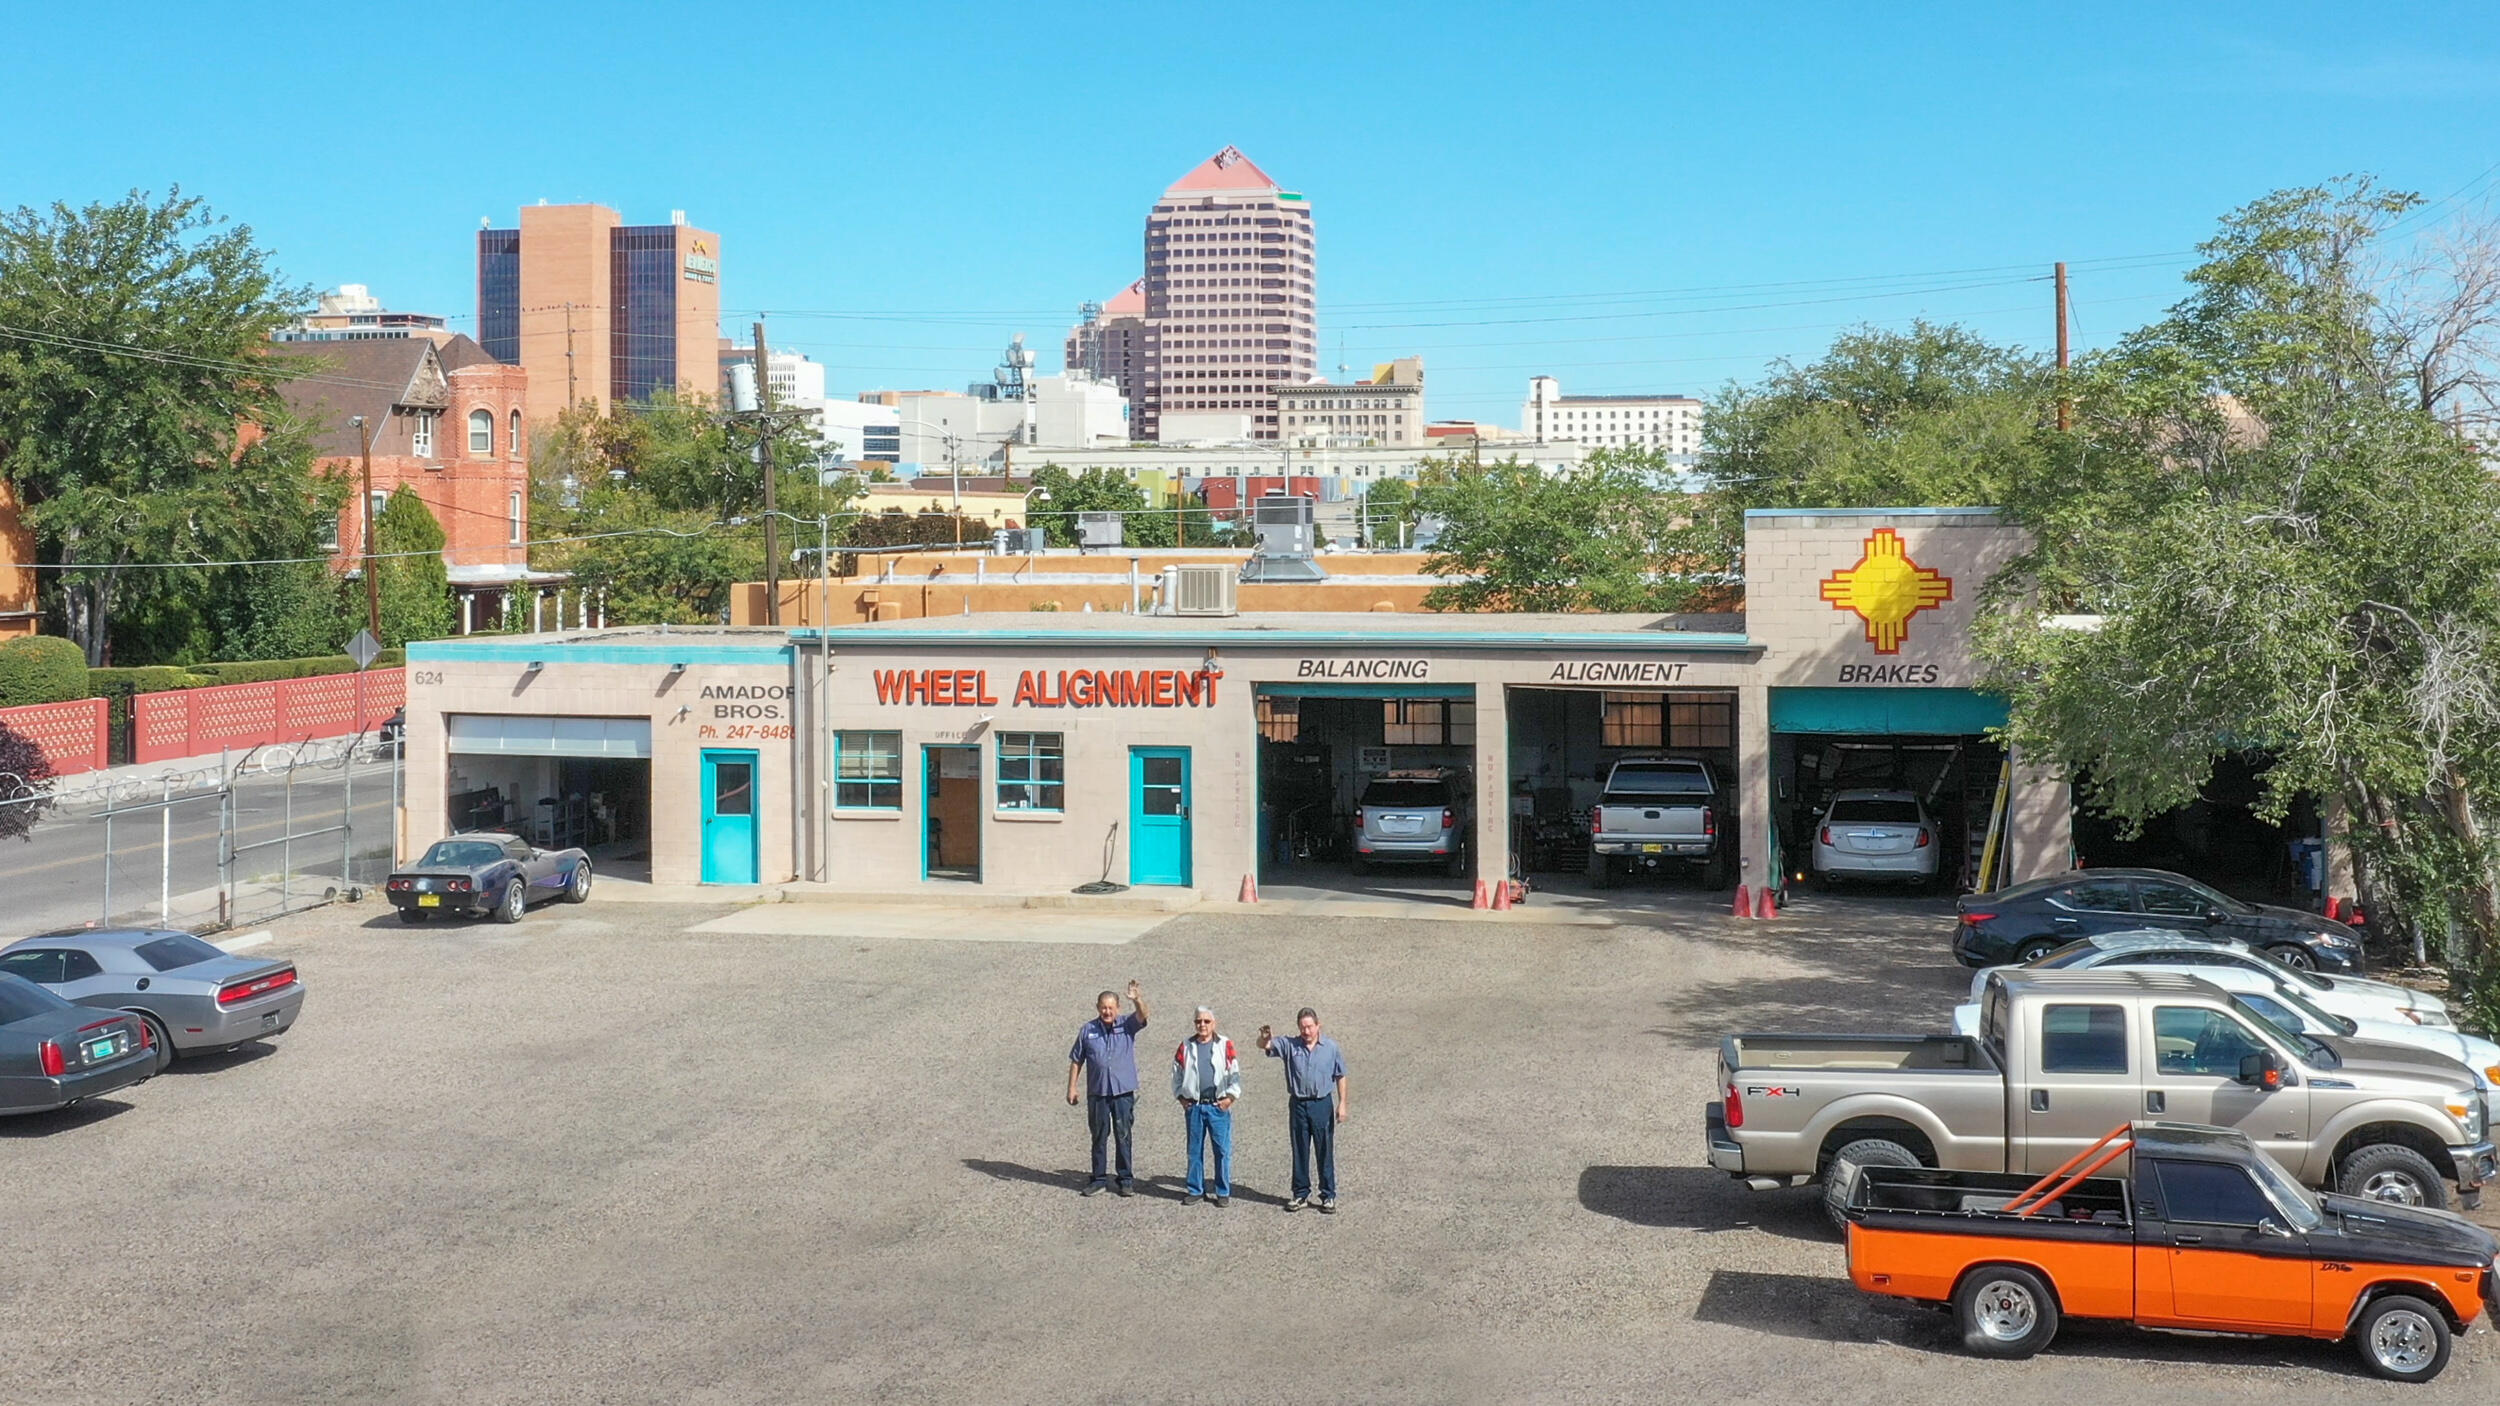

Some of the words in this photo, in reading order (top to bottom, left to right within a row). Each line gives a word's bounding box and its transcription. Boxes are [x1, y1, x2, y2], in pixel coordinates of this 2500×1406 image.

[1297, 660, 1429, 678] BALANCING
[1550, 662, 1688, 681] ALIGNMENT
[1838, 664, 1939, 684] BRAKES
[415, 671, 444, 685] 624
[873, 669, 998, 705] WHEEL
[1013, 669, 1224, 708] ALIGNMENT
[714, 705, 785, 719] BROS.
[699, 725, 719, 738] Ph.
[1747, 1086, 1799, 1097] FX4
